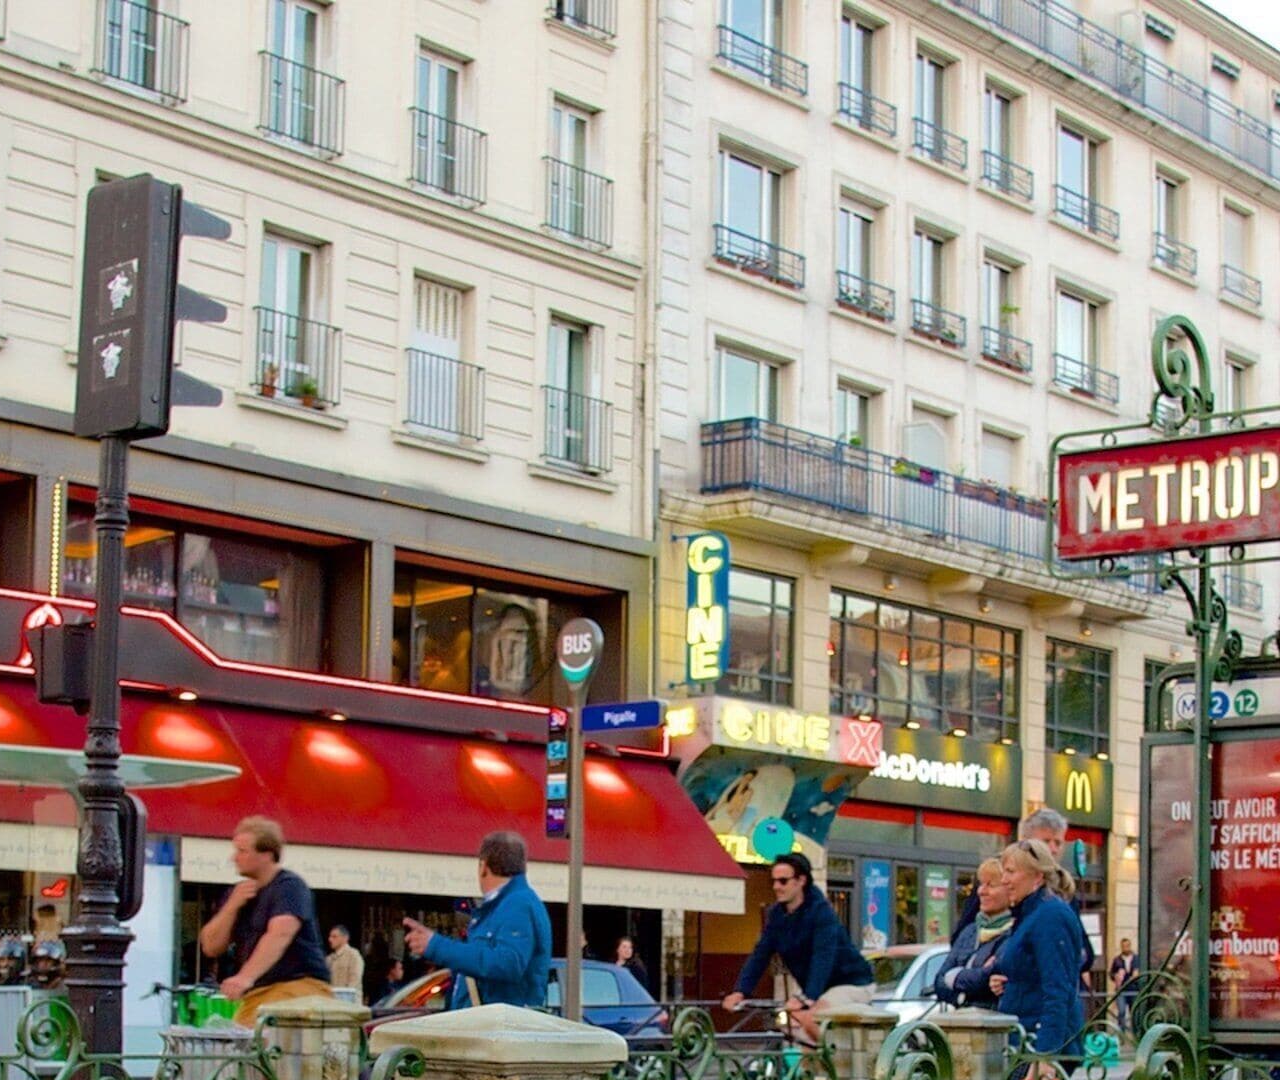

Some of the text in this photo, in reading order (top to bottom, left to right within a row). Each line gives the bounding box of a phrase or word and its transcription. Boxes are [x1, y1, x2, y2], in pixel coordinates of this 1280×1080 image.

[688, 535, 723, 680] CINE
[562, 632, 593, 655] BUS
[1236, 693, 1255, 712] 12
[603, 710, 637, 726] Pigalle
[723, 704, 830, 752] CINE
[1171, 801, 1193, 822] ON
[1234, 797, 1277, 819] AVOIR
[1210, 850, 1231, 870] NS
[1234, 849, 1252, 869] LE
